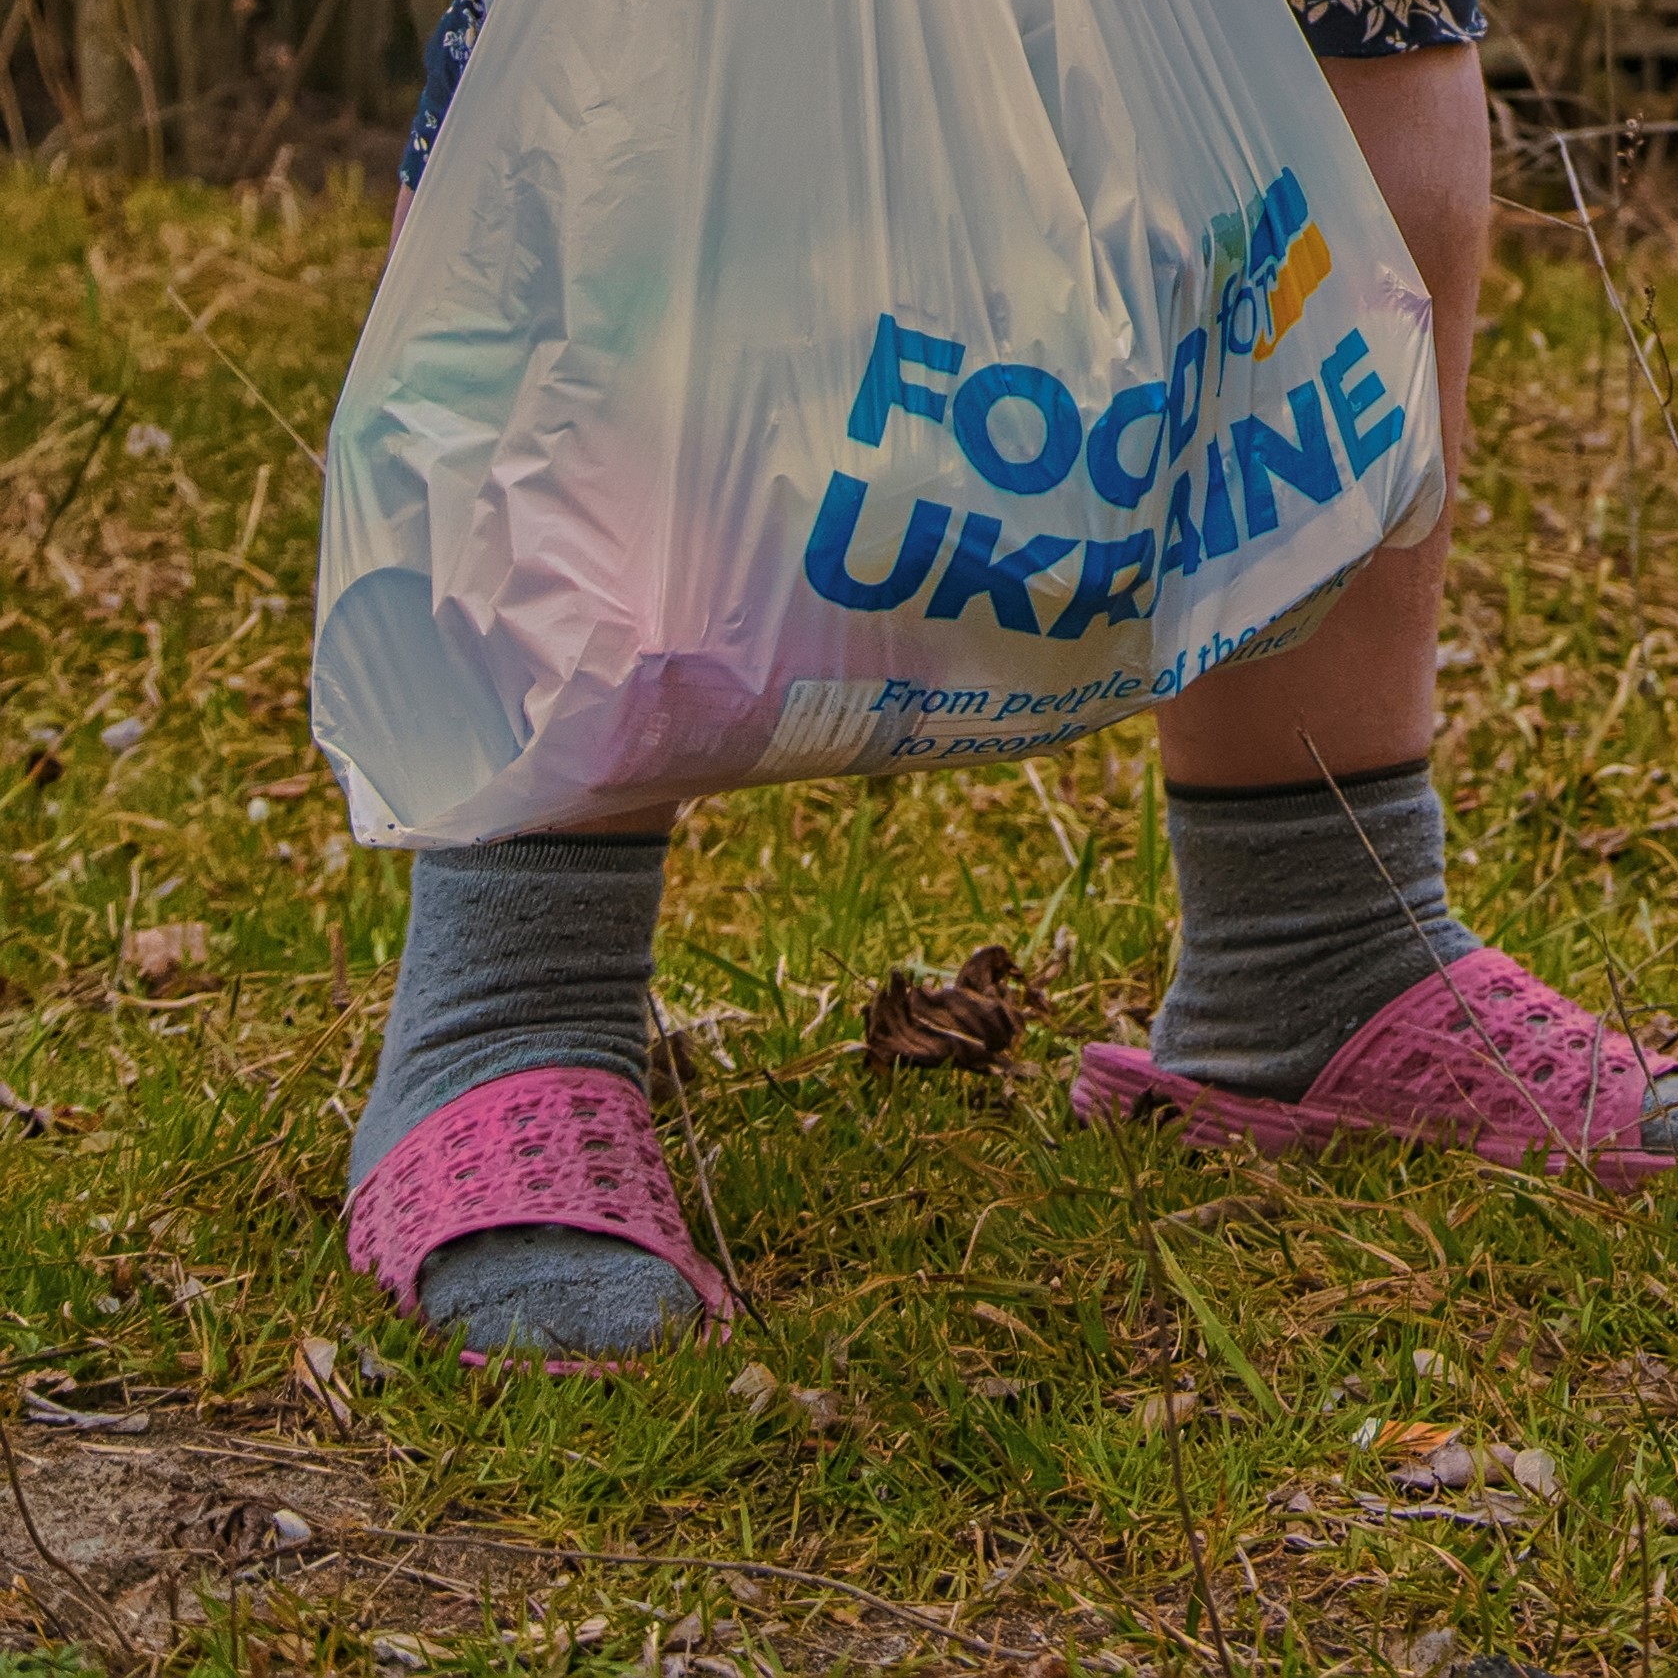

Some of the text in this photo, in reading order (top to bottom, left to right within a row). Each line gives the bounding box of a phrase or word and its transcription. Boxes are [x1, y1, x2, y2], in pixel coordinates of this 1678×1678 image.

[847, 263, 1277, 510] FOOD for
[804, 327, 1406, 640] UKRAINE
[868, 677, 992, 715] From
[990, 669, 1143, 722] people
[1151, 649, 1188, 695] of
[889, 734, 937, 759] to
